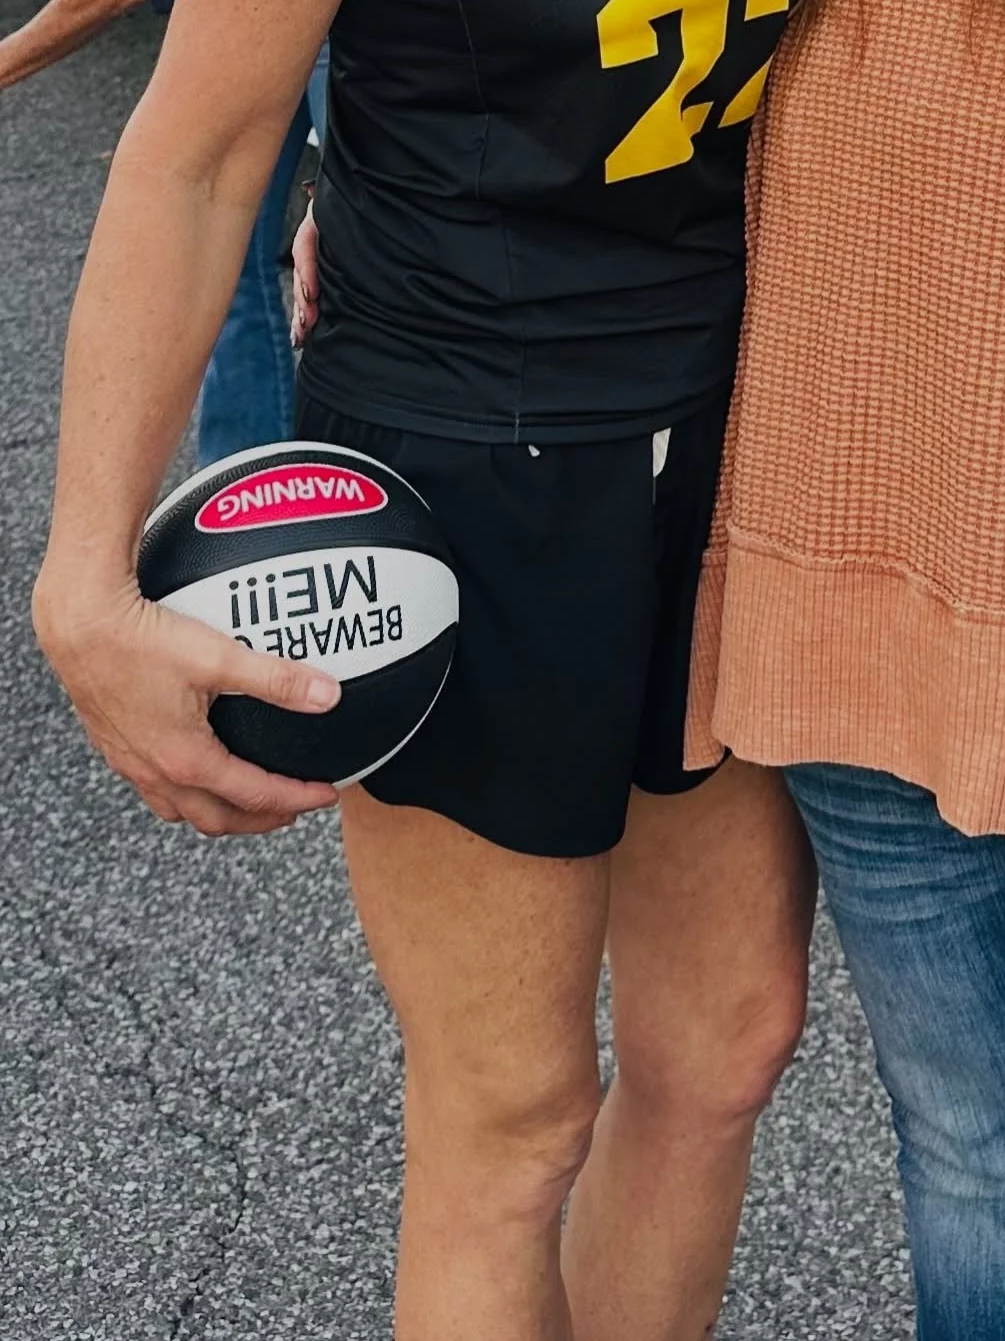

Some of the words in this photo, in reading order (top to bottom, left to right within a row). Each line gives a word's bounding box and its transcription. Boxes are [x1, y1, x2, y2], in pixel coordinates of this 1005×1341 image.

[217, 477, 366, 522] WARNING
[228, 555, 378, 629] ME!!!
[263, 605, 403, 661] BEWARE
